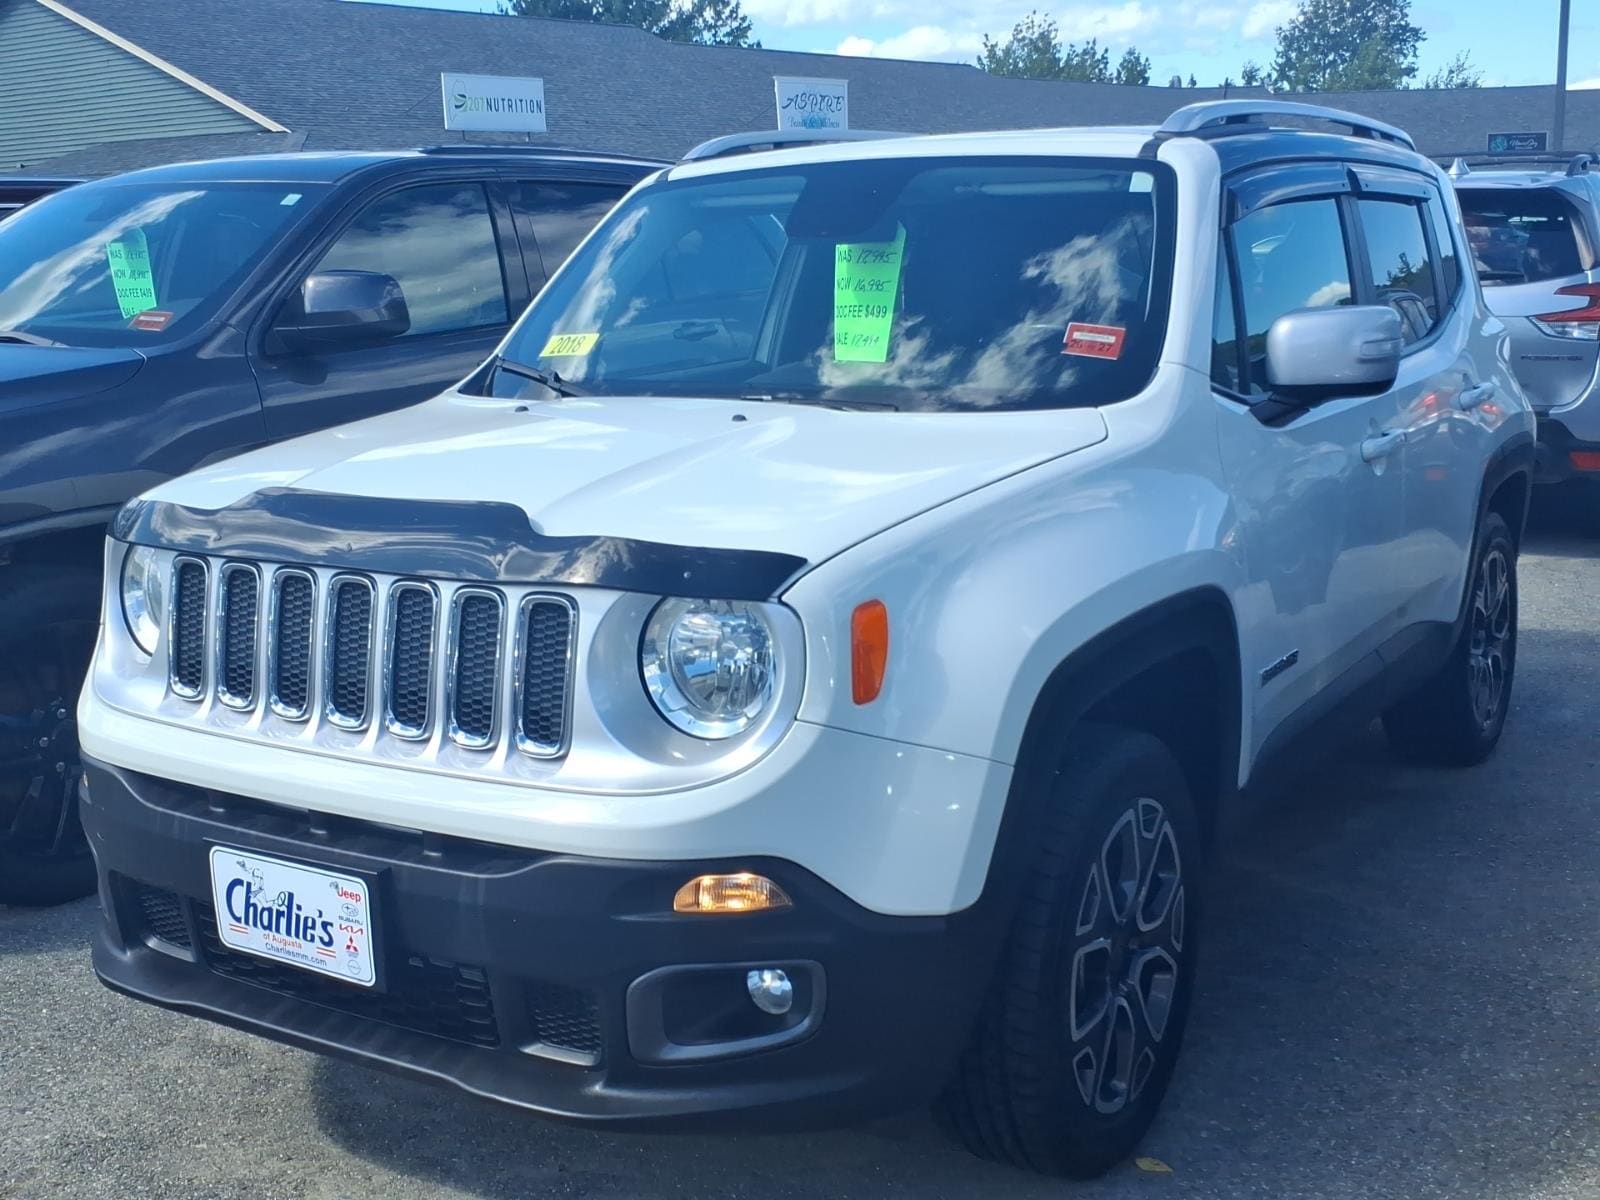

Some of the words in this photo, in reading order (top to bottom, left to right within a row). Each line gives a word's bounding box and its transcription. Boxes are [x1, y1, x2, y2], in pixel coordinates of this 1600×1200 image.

[781, 92, 845, 113] ASPIRE
[864, 303, 888, 318] $499
[549, 335, 586, 354] 2018
[337, 886, 362, 903] Jeep
[225, 877, 335, 948] Charlie's
[262, 932, 271, 941] of
[271, 933, 302, 950] Augusta
[265, 942, 328, 967] Charliesmm.com
